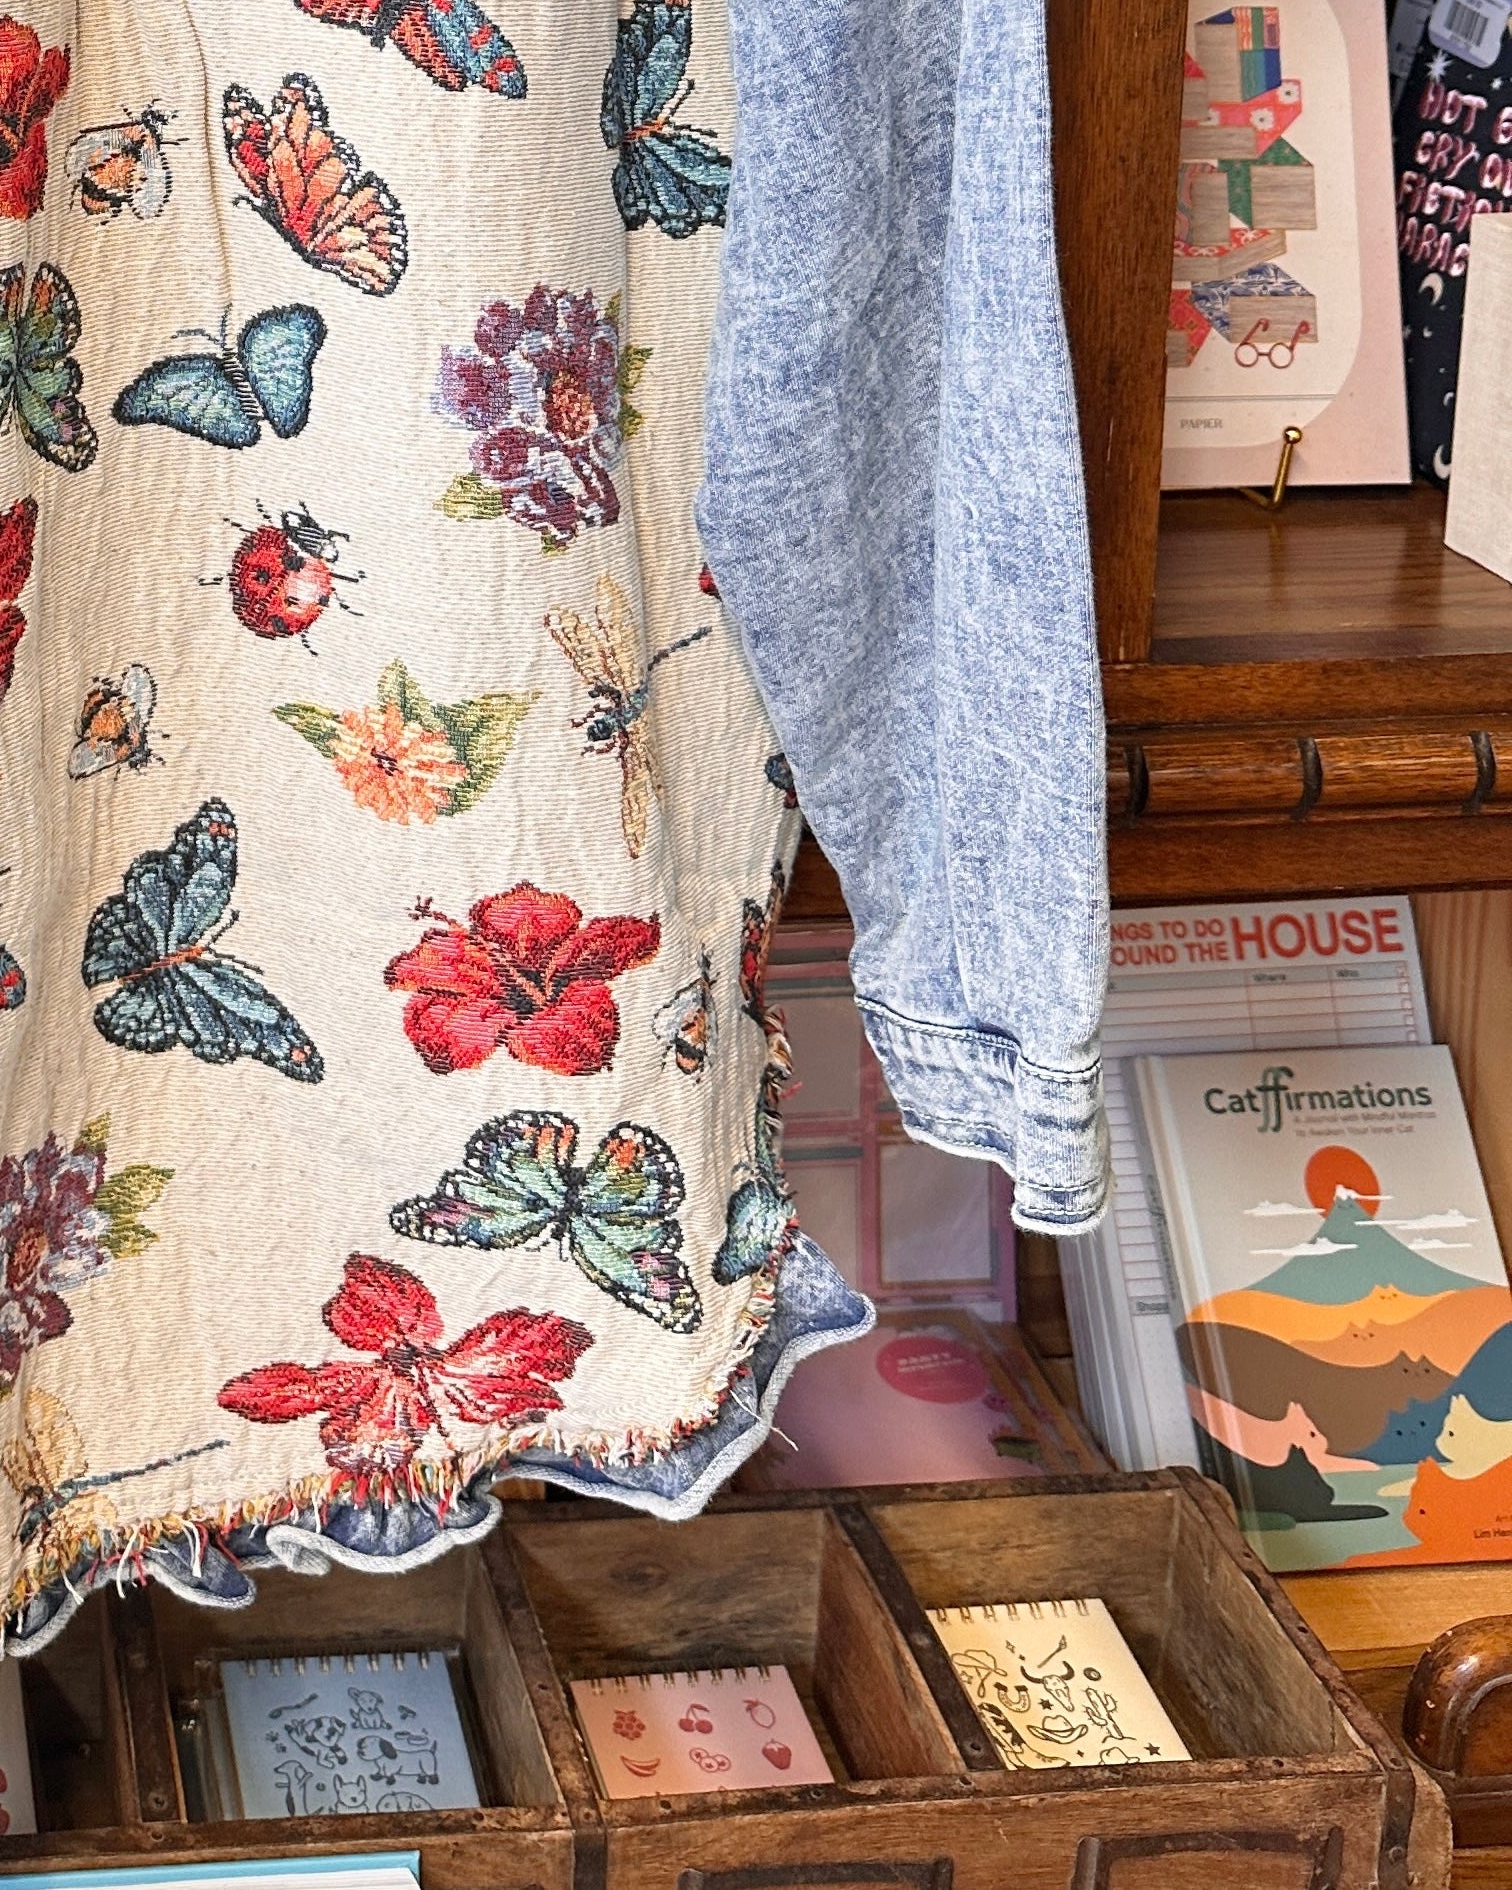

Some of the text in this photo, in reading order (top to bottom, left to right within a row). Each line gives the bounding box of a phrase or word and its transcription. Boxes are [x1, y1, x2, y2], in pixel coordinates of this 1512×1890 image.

[1159, 921, 1187, 939] TO
[1194, 918, 1225, 938] DO
[1230, 908, 1404, 960] HOUSE
[1184, 941, 1229, 961] THE
[1204, 1066, 1433, 1133] Catffirmations
